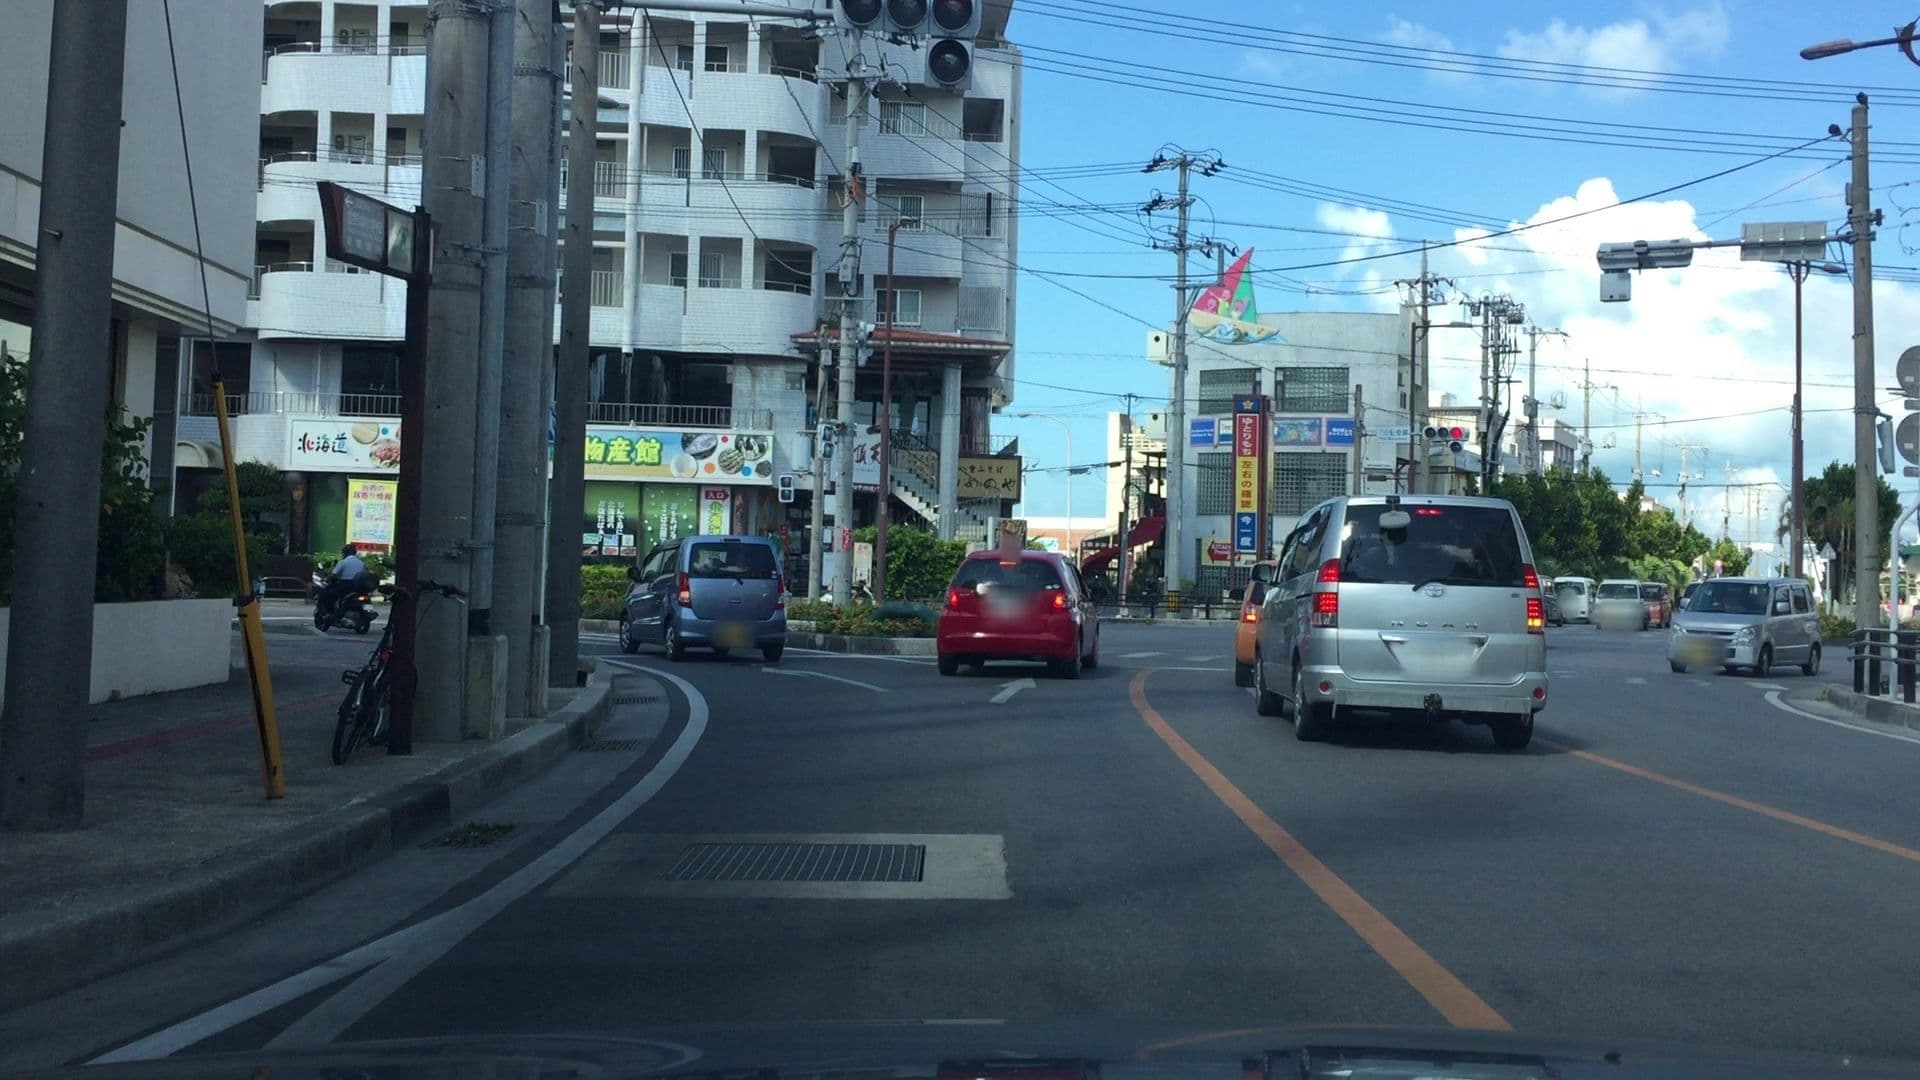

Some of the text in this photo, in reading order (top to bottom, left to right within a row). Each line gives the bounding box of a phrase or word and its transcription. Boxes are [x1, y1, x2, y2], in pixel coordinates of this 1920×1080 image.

[297, 432, 348, 454] 北海道
[585, 435, 662, 465] 物産館
[707, 491, 725, 499] 入口
[1240, 460, 1253, 509] 左右の確認
[1239, 515, 1253, 547] 今一度
